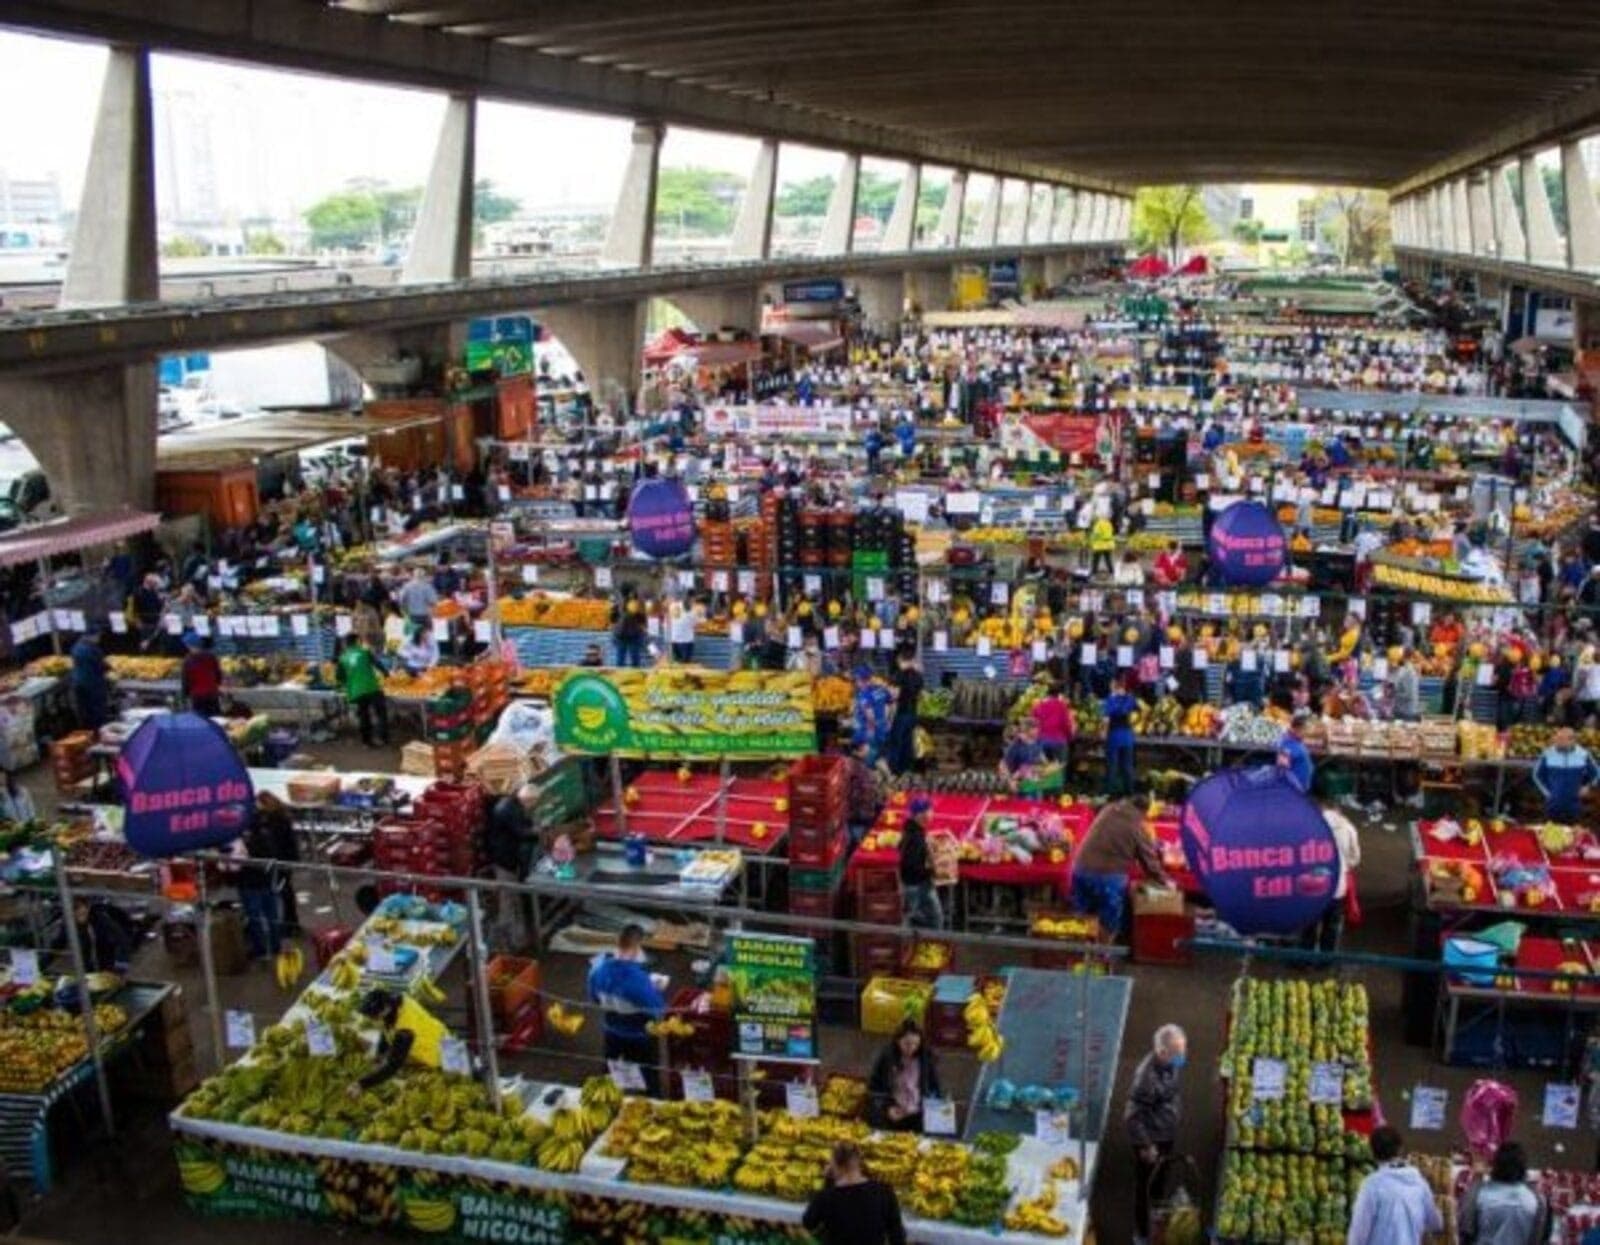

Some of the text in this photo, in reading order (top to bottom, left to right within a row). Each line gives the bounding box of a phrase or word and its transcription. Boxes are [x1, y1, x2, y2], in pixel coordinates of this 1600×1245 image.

[132, 780, 247, 814] Banca do
[1212, 839, 1334, 872] Banca do
[1254, 876, 1292, 897] Edi
[732, 938, 806, 955] BANANAS
[736, 952, 803, 968] NICOLAU
[460, 1197, 562, 1229] BANANAS
